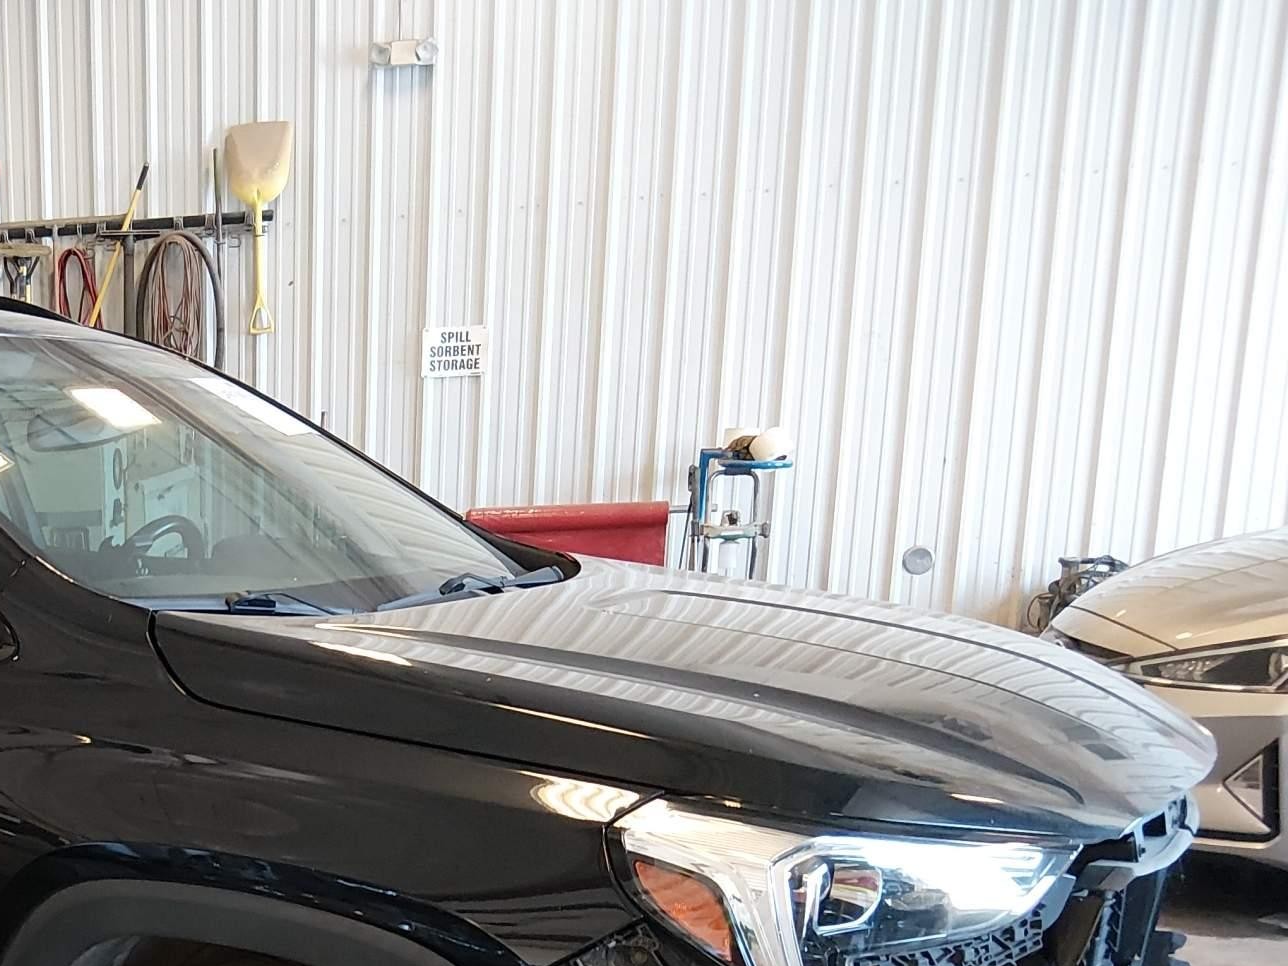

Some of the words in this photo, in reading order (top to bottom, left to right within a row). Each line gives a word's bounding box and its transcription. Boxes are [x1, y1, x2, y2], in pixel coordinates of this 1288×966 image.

[440, 330, 471, 344] SPILL
[429, 343, 482, 358] SORBENT
[429, 357, 481, 372] STORAGE
